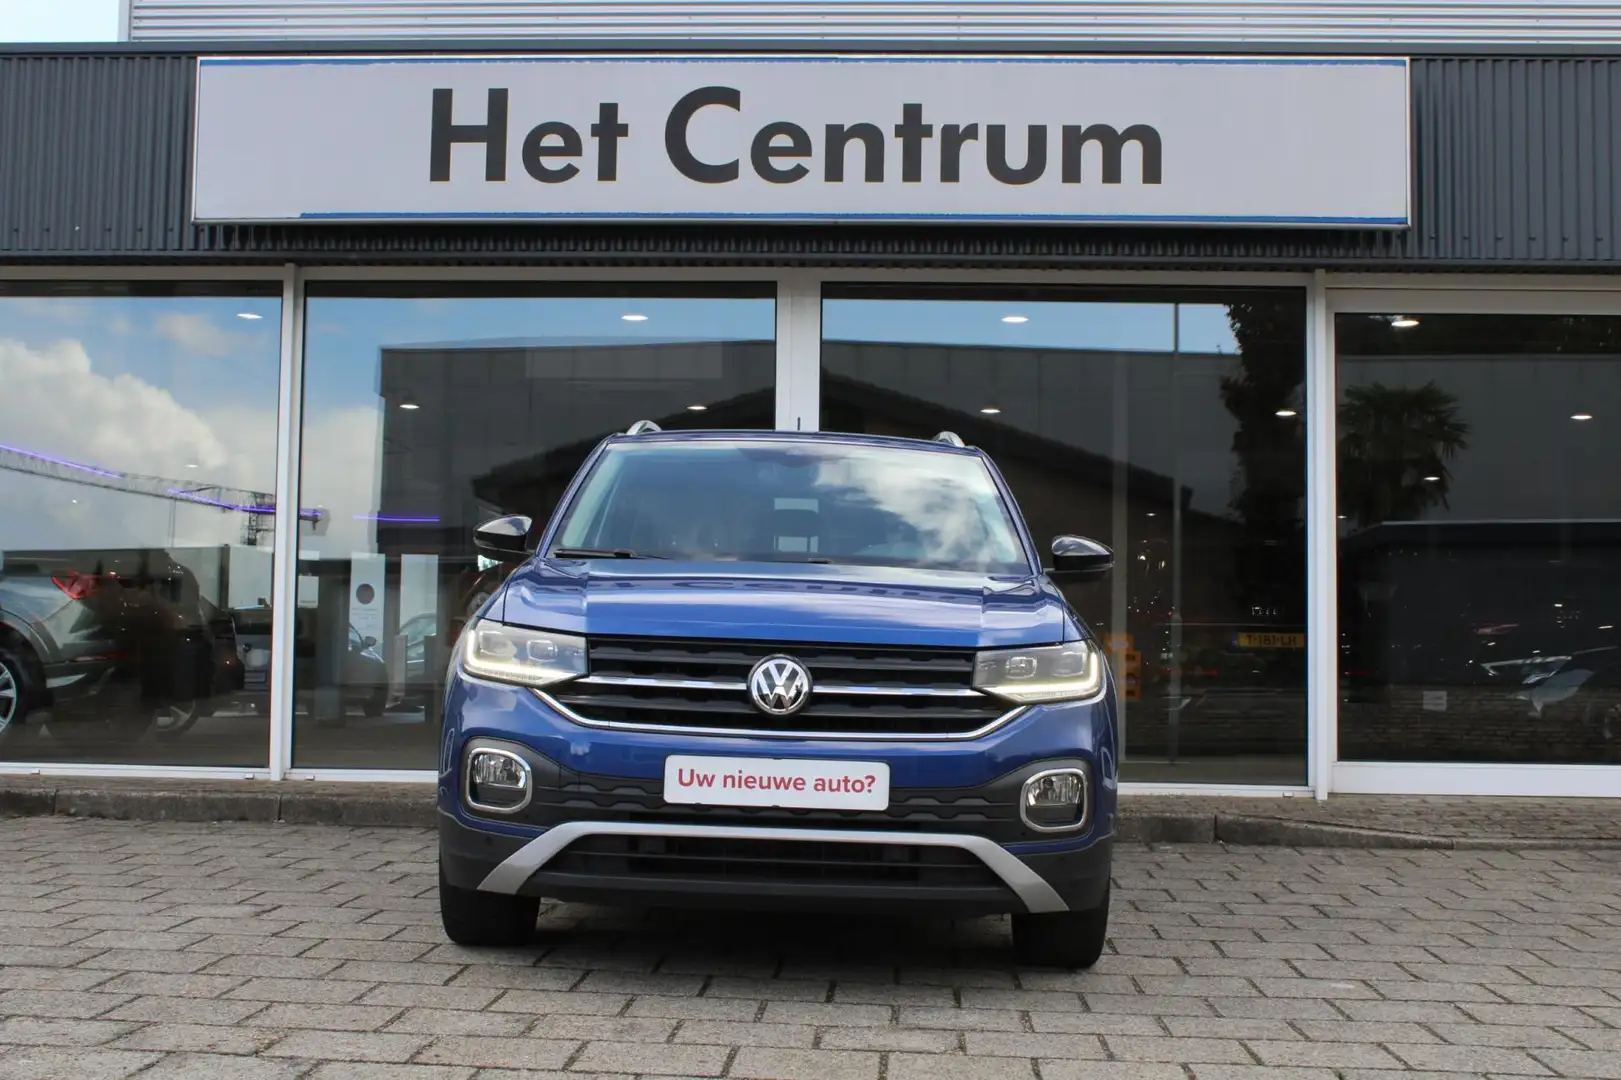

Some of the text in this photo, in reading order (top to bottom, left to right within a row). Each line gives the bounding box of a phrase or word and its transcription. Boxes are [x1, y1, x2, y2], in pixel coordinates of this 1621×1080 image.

[430, 85, 1163, 187] Het Centrum
[678, 768, 877, 794] Uw nieuwe auto?
